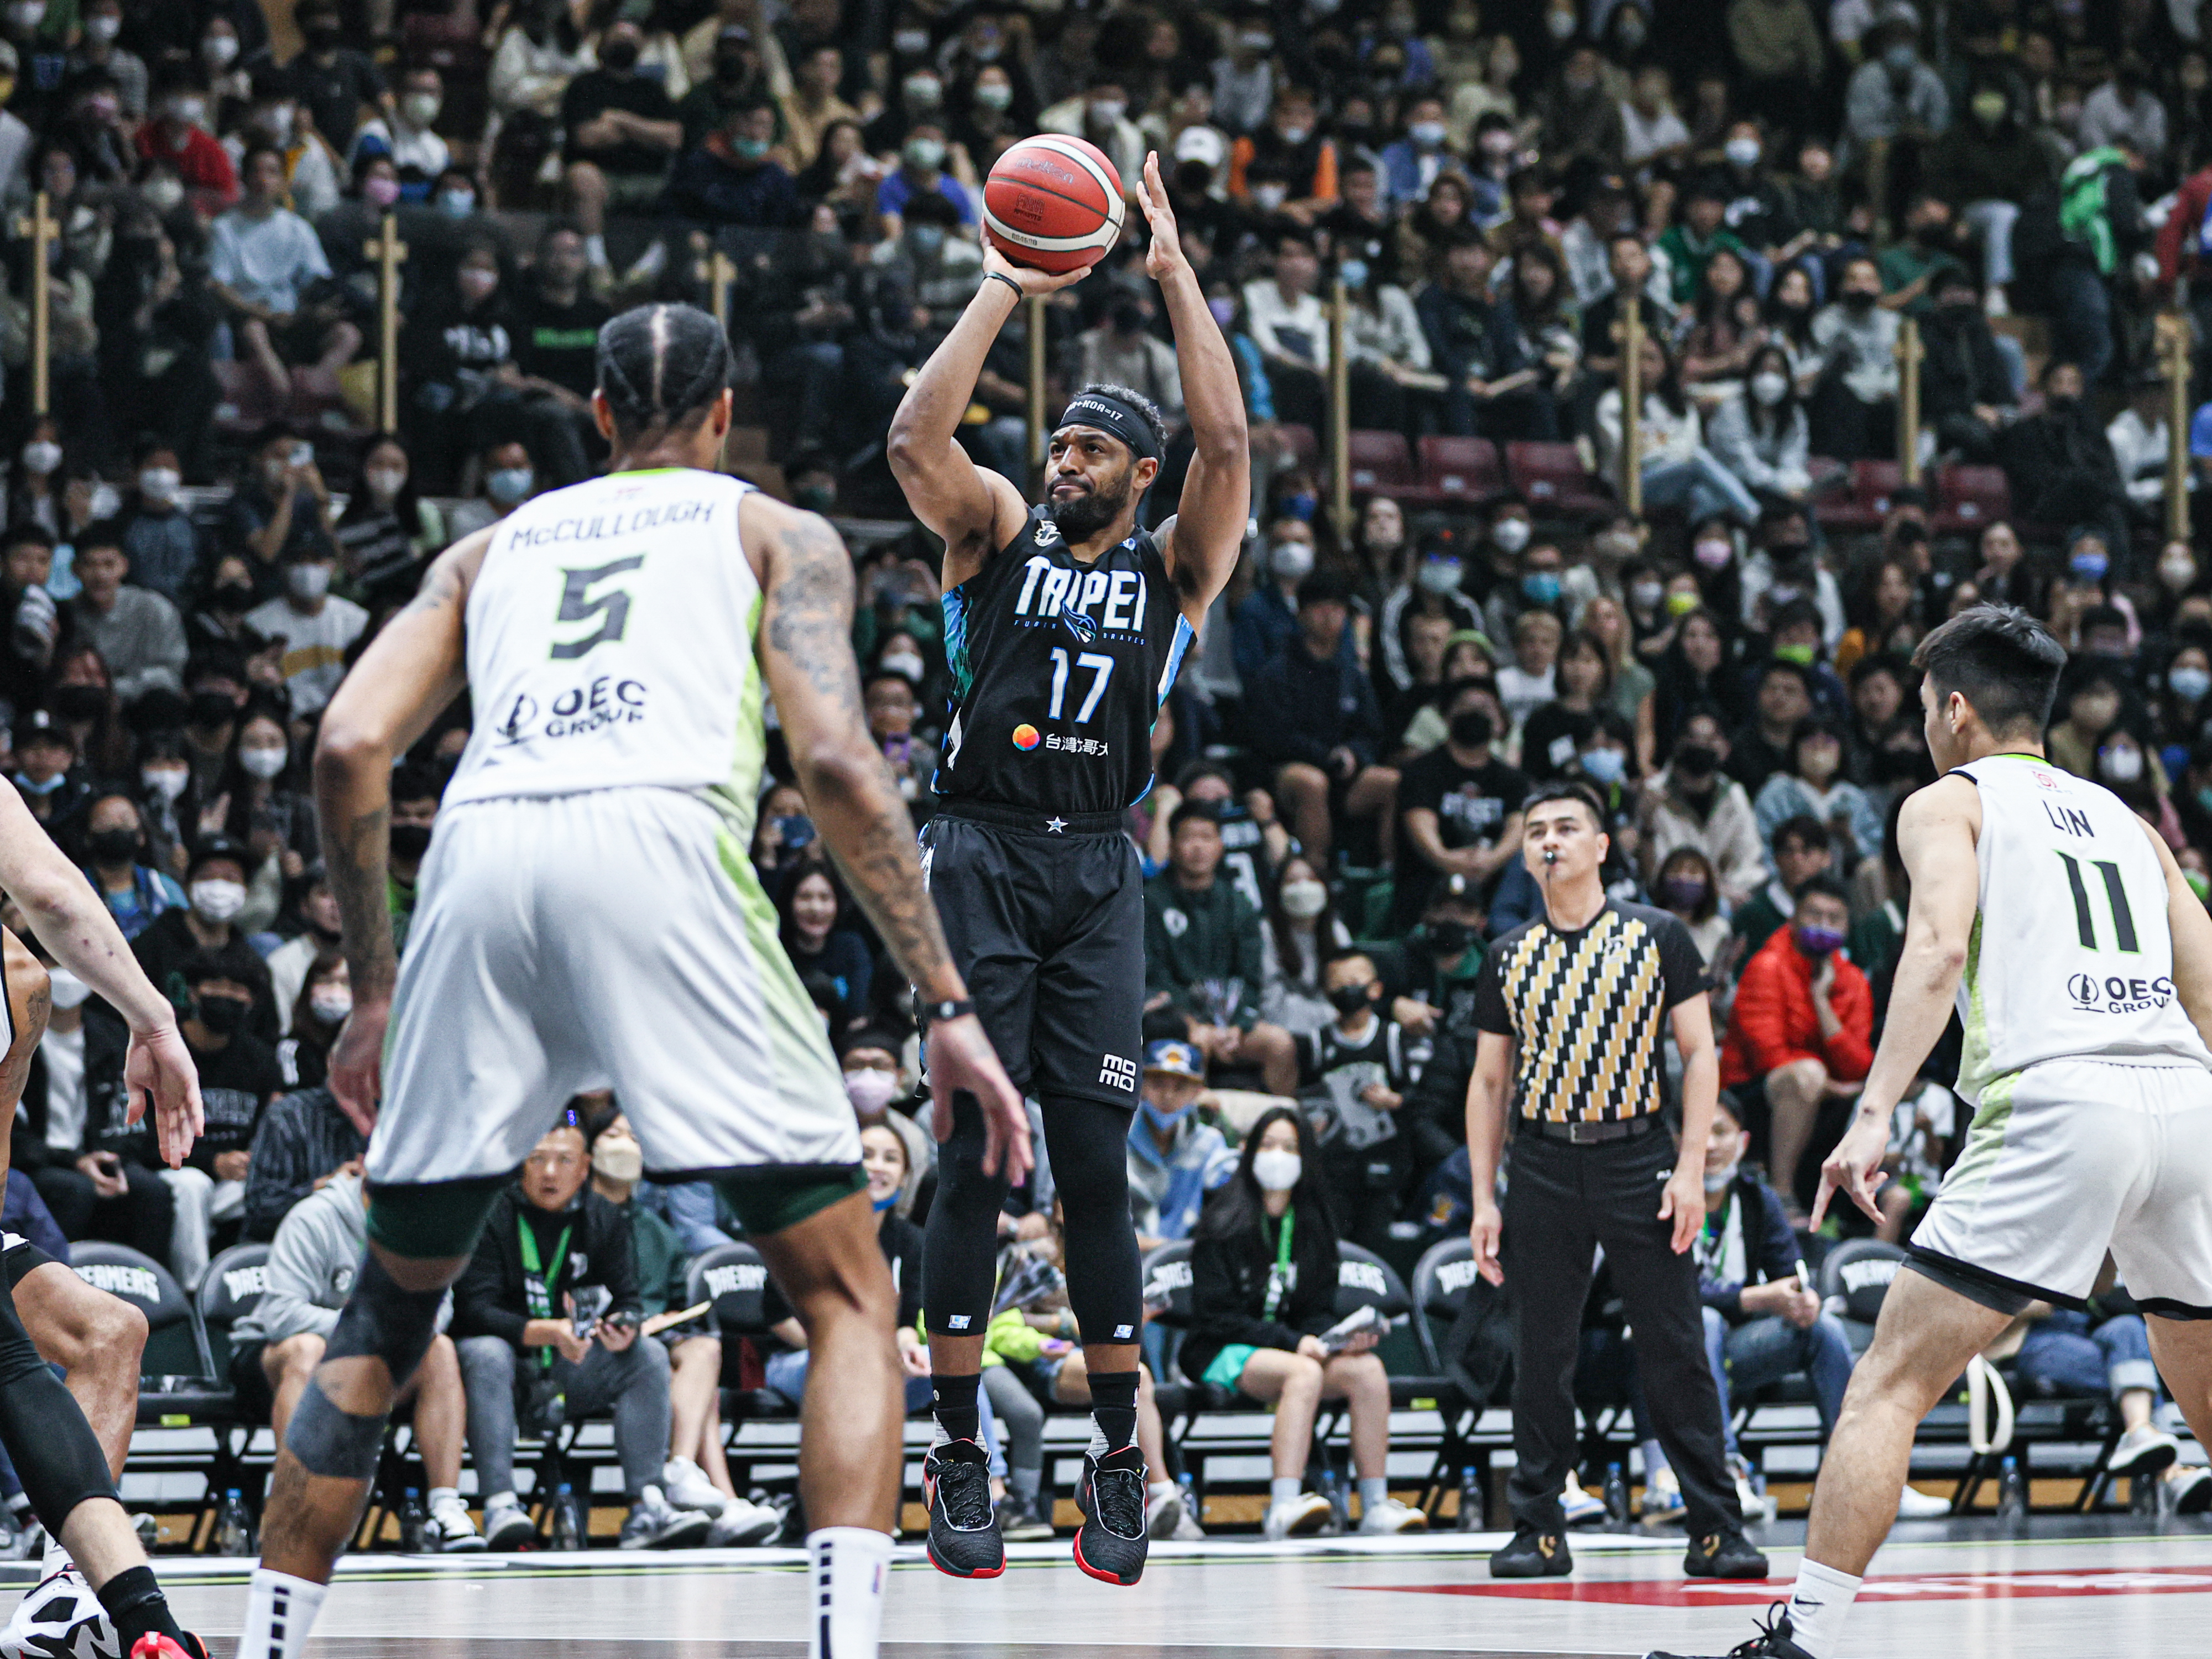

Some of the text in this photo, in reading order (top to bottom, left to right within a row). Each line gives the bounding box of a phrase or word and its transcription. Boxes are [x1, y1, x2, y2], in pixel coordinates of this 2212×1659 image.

[549, 553, 647, 660] 5
[1014, 555, 1148, 633] TAIPEI
[1103, 632, 1145, 646] BRAVES
[553, 676, 647, 716] OEC
[1049, 646, 1115, 723] 17
[2042, 800, 2095, 837] LIN
[2052, 849, 2142, 954] 11
